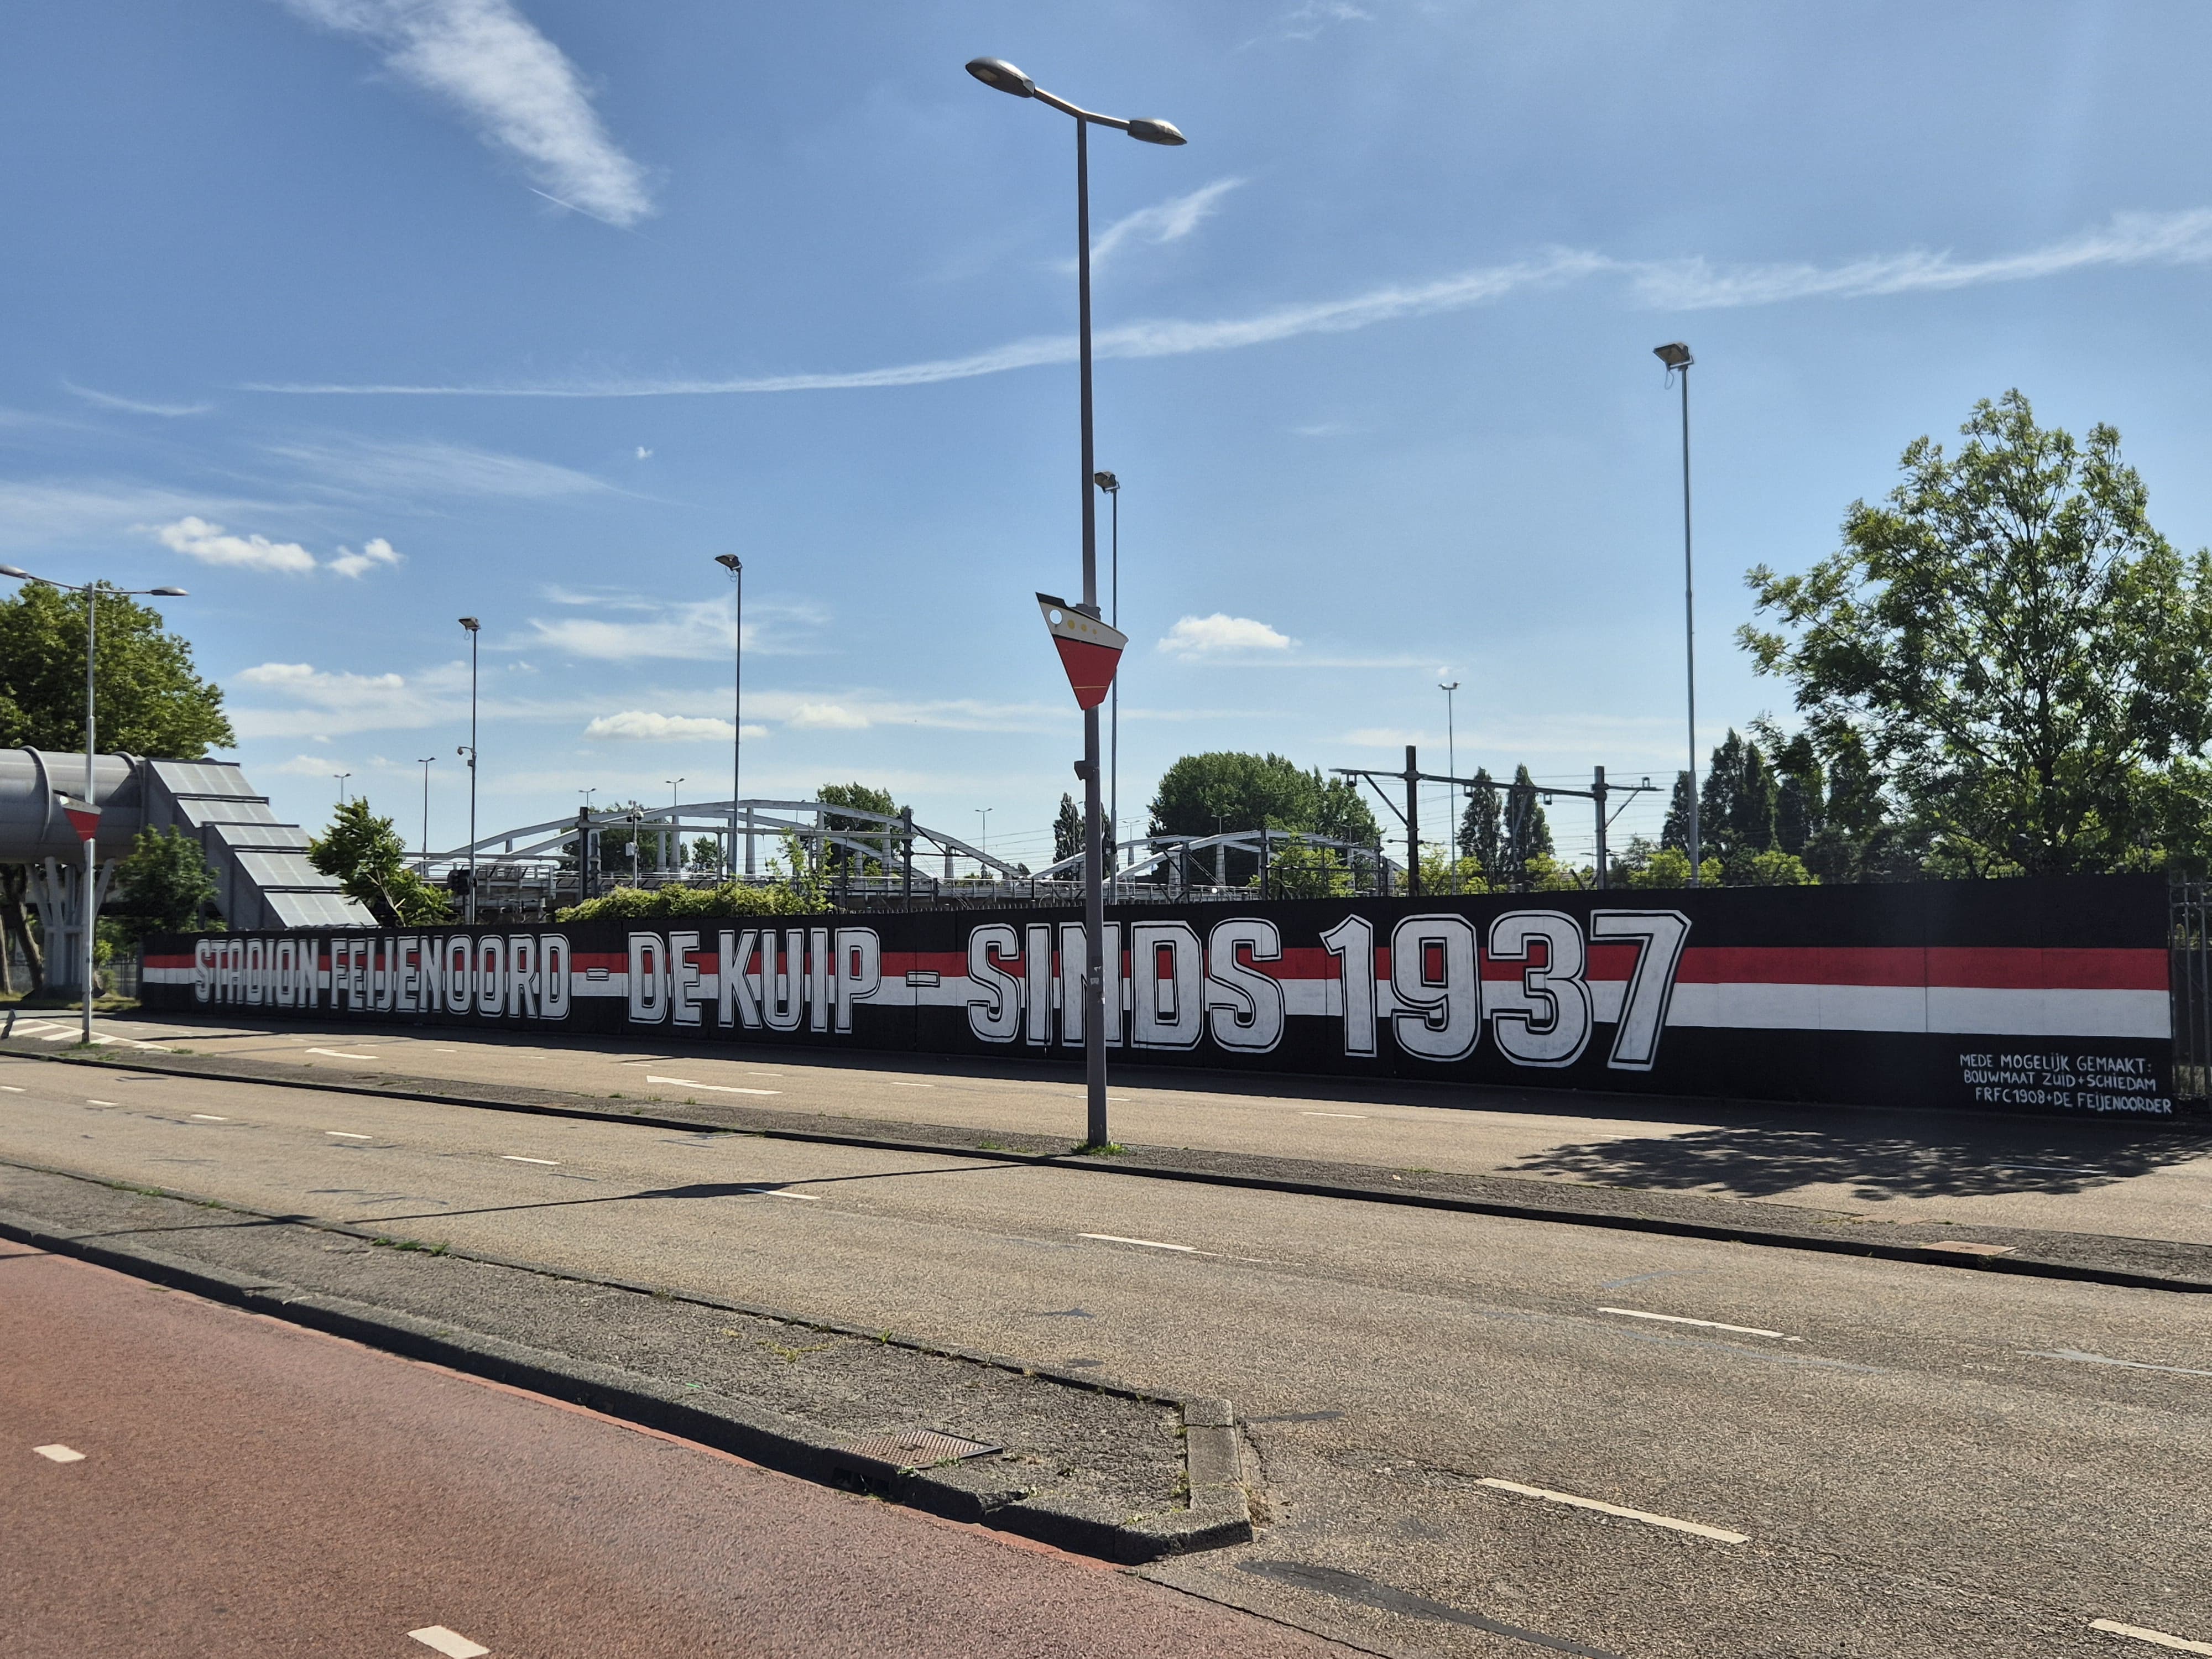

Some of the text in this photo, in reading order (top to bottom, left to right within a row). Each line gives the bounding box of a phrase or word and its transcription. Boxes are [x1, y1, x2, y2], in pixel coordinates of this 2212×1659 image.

[195, 938, 319, 1009] STADION
[331, 933, 571, 1021] FEIJENOORD
[628, 931, 702, 1026] DE
[718, 926, 881, 1034] KUIP
[967, 917, 1285, 1053] SINDS
[1319, 909, 1692, 1071] 1937
[1959, 1053, 1993, 1068] MEDE
[2077, 1056, 2152, 1074] GEMAAKT:
[1964, 1069, 2035, 1084] BOUWMAAT
